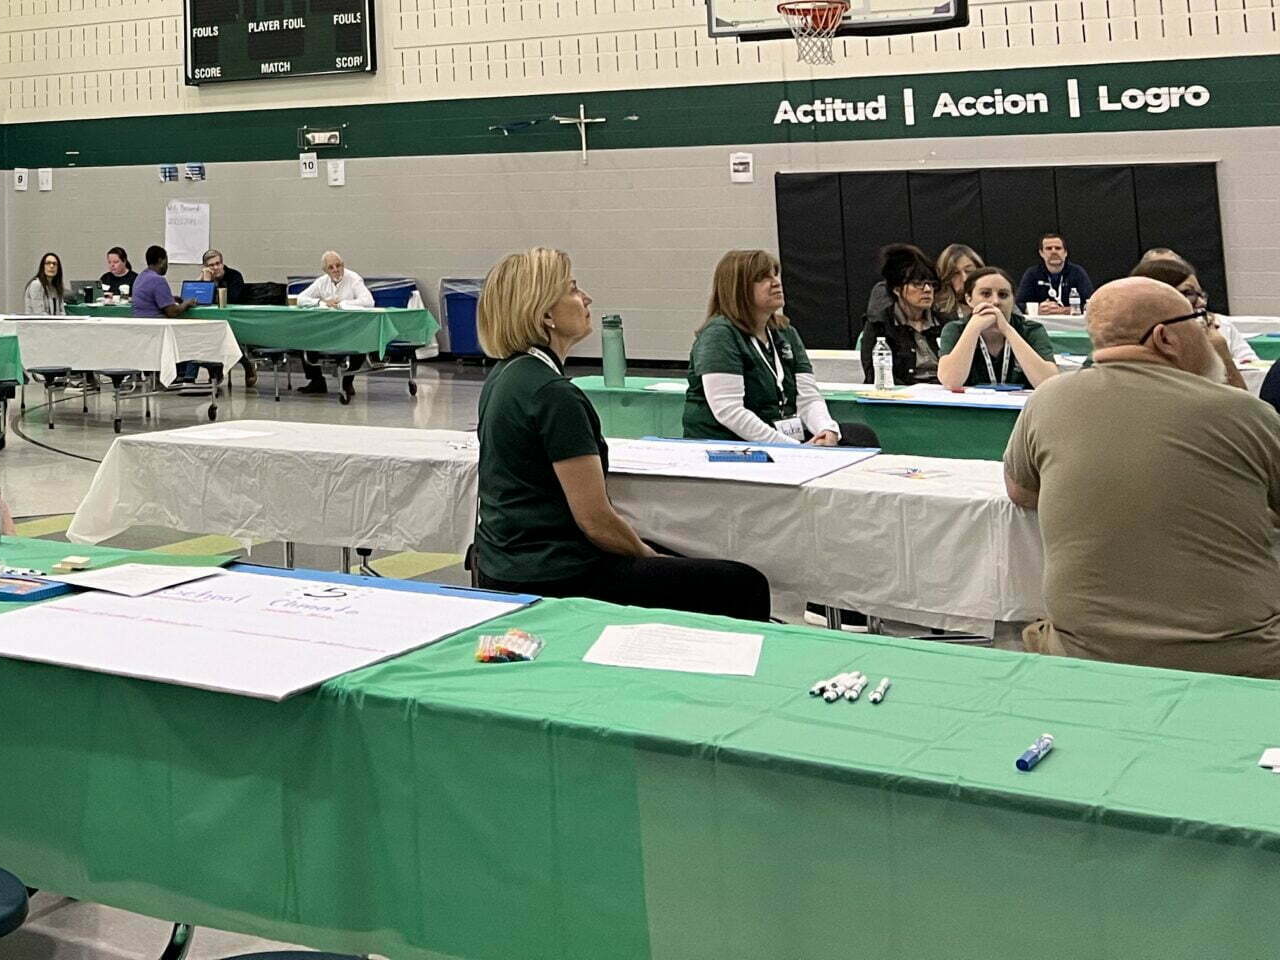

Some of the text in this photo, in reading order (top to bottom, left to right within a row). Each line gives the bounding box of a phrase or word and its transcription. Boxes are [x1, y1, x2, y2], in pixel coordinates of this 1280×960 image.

[333, 12, 361, 25] FOULS
[248, 18, 306, 33] PLAYER FOUL
[192, 26, 219, 38] FOULS
[194, 67, 222, 79] SCORE
[261, 62, 291, 74] MATCH
[773, 95, 886, 125] Actitud
[933, 88, 1048, 118] Accion
[1098, 85, 1210, 114] Logro
[303, 161, 314, 170] 10
